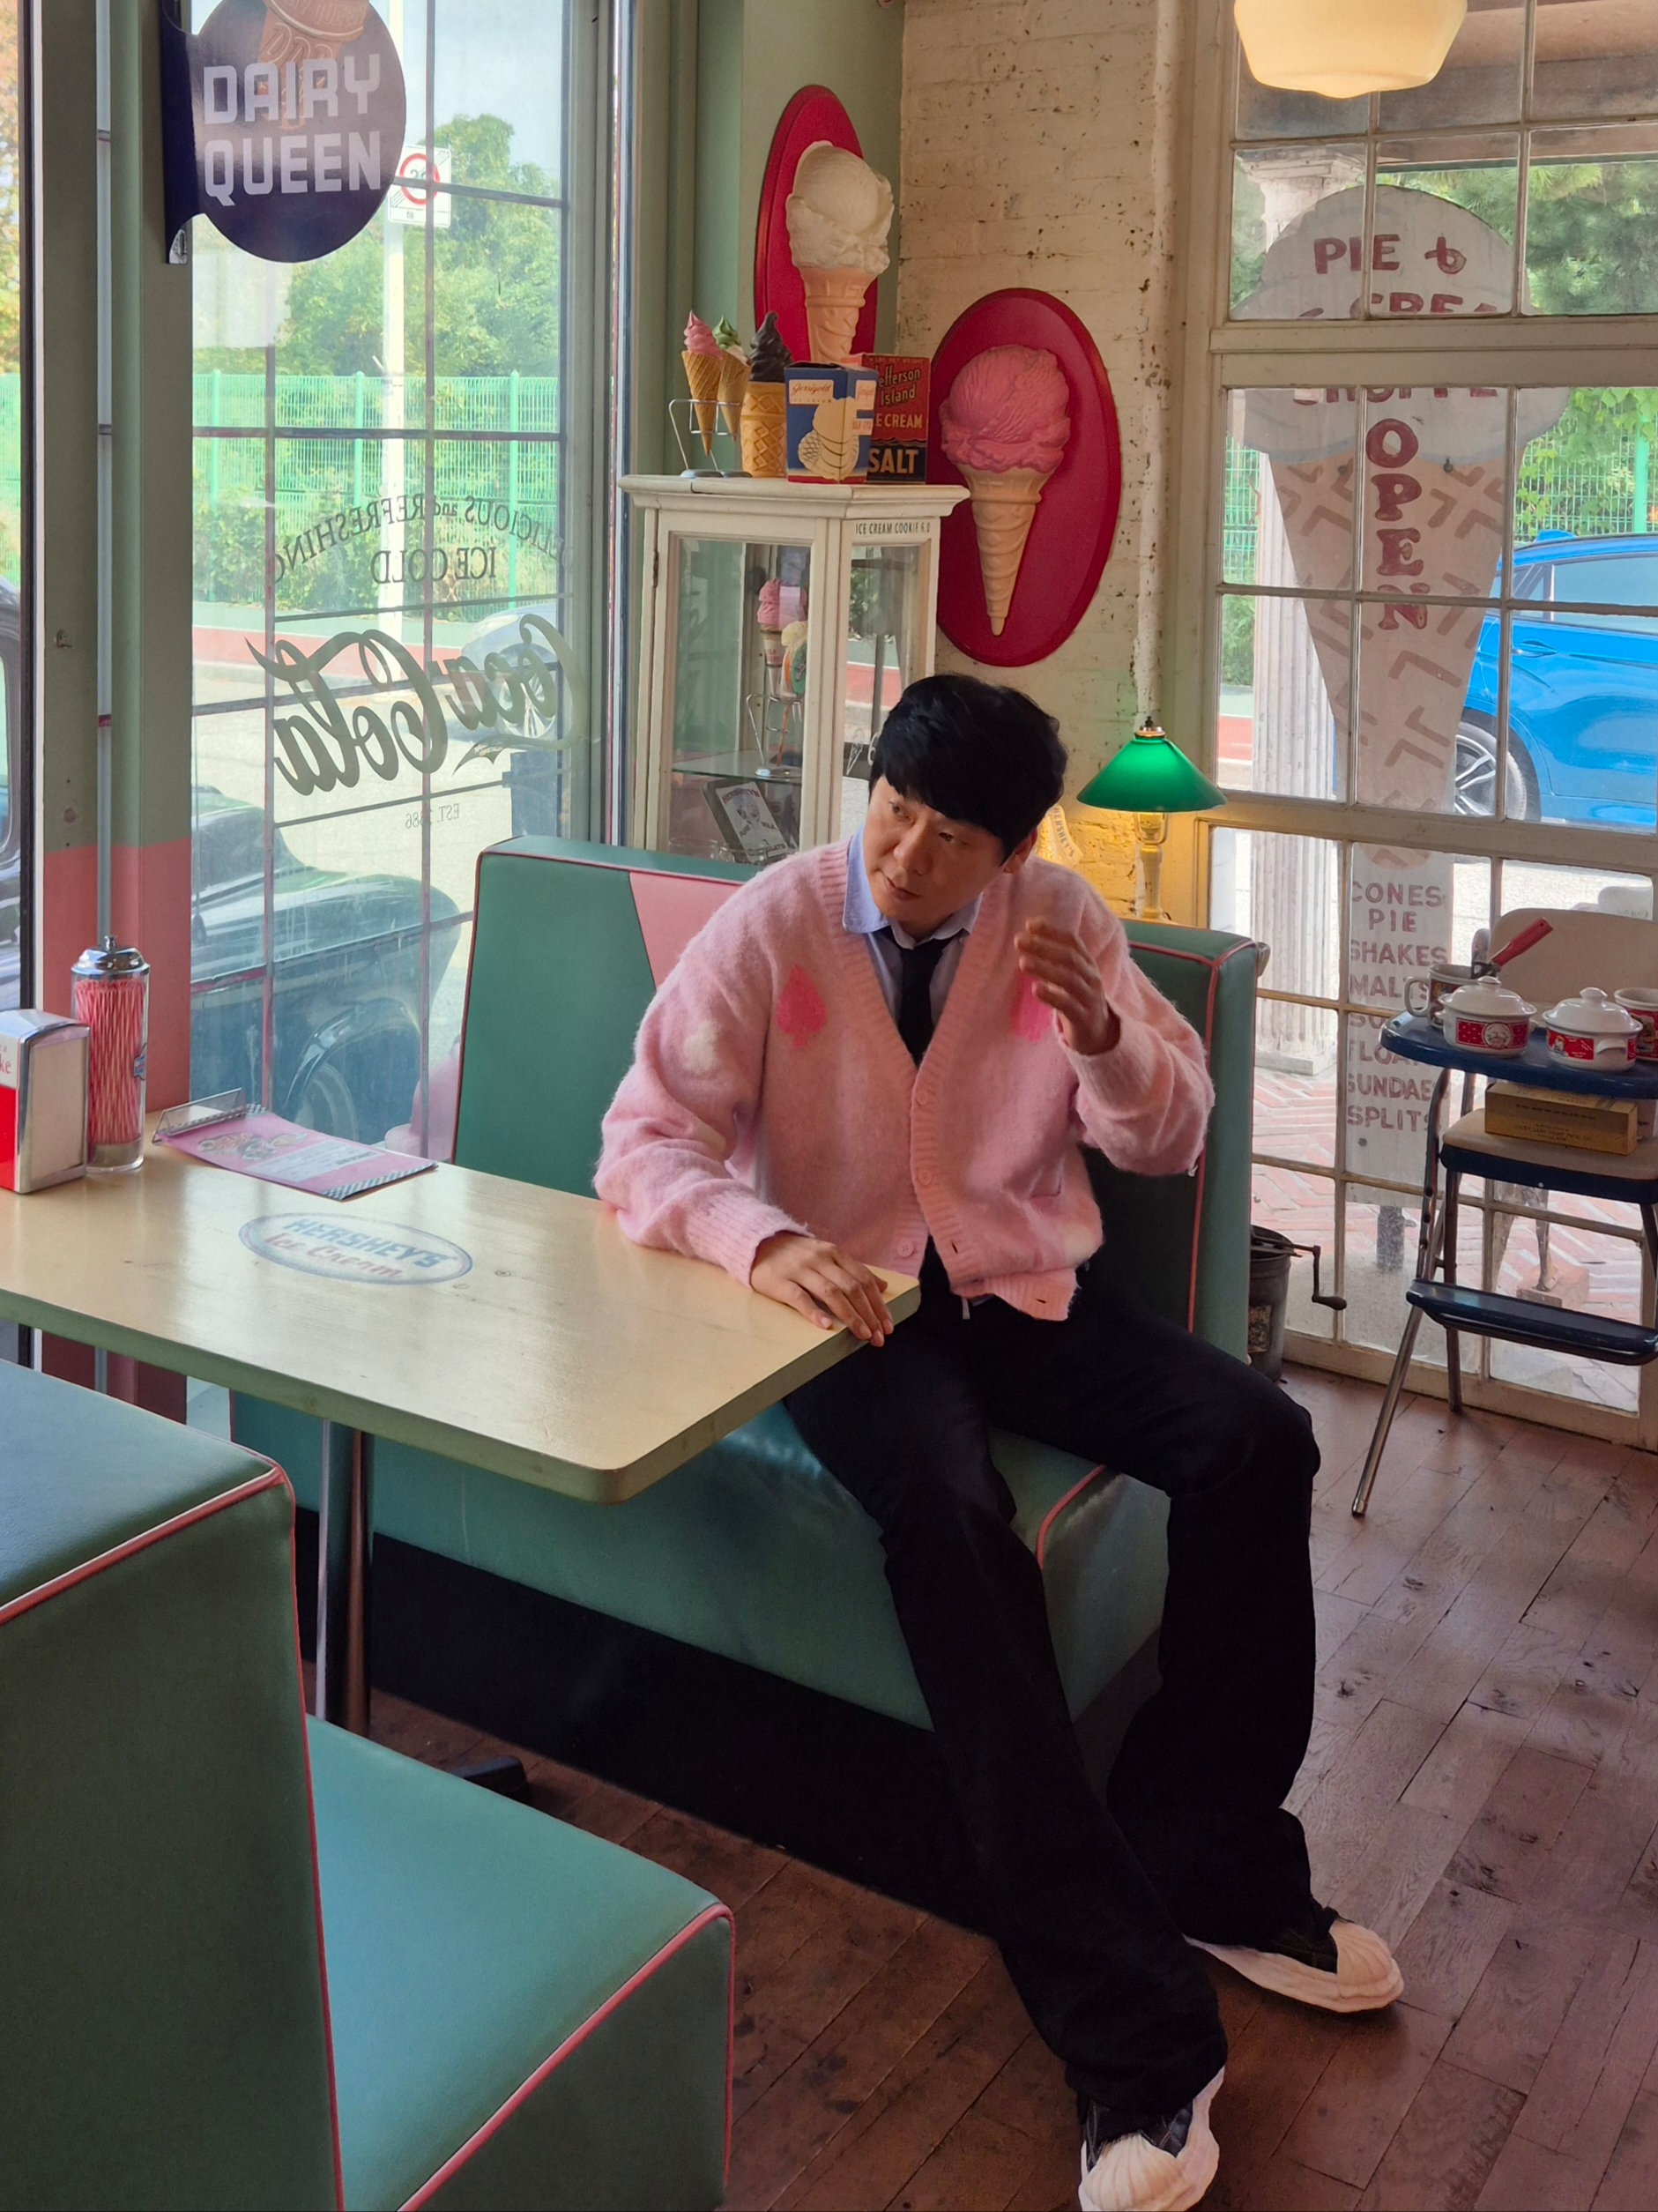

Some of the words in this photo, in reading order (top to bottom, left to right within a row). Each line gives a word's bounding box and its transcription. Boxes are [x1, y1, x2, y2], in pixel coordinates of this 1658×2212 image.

[204, 54, 380, 124] DAIRY
[204, 130, 381, 206] QUEEN
[1314, 235, 1401, 274] PIE
[875, 364, 920, 388] efferson
[881, 384, 916, 406] Island
[884, 413, 923, 428] CREAM
[868, 448, 919, 473] SALT
[855, 523, 866, 534] ICE
[869, 522, 893, 534] CREAM
[1366, 418, 1431, 630] OPEN
[1368, 907, 1417, 933] PIE
[1350, 939, 1448, 968] SHAKES
[1348, 1073, 1448, 1102] SUNDAE
[1347, 1104, 1440, 1132] SPLIT
[265, 1233, 306, 1251] Ice
[306, 1245, 403, 1277] Cream
[283, 1218, 454, 1268] HERSHEY'S
